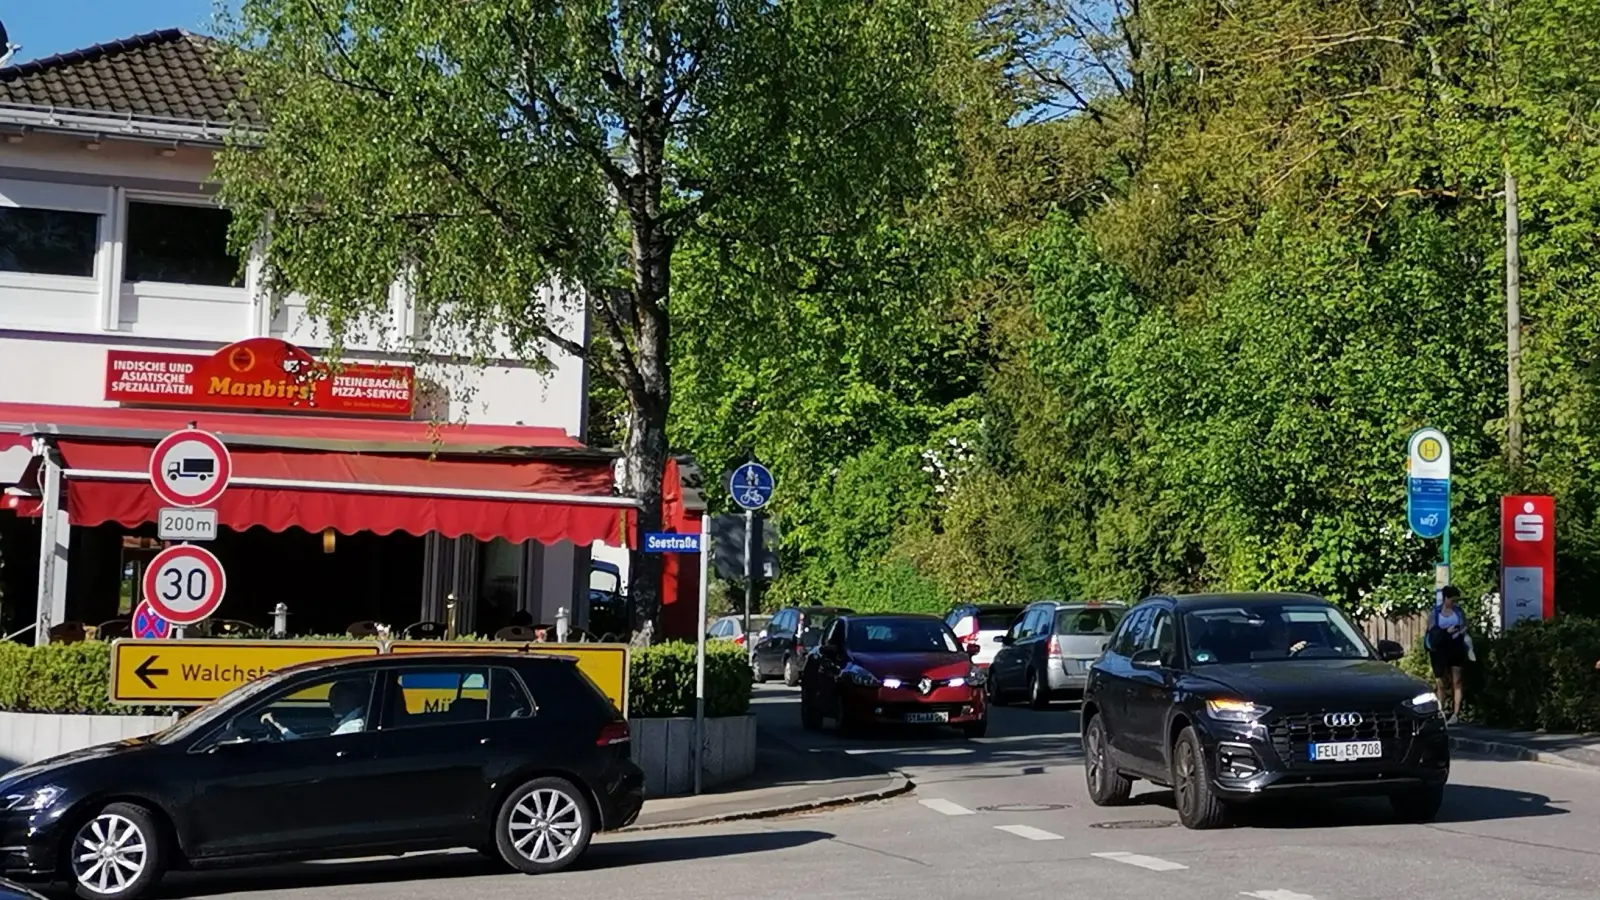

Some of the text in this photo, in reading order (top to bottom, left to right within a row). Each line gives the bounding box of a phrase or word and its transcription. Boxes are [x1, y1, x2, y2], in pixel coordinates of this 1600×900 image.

[113, 360, 194, 374] INDISCHE UND
[120, 371, 185, 384] ASIATISCHE
[111, 381, 193, 395] SPEZIALITÄTEN
[331, 386, 409, 400] PIZZA-SERVICE
[648, 535, 698, 549] Seestraße
[162, 568, 207, 601] 30
[1317, 743, 1380, 758] FEU ER 708
